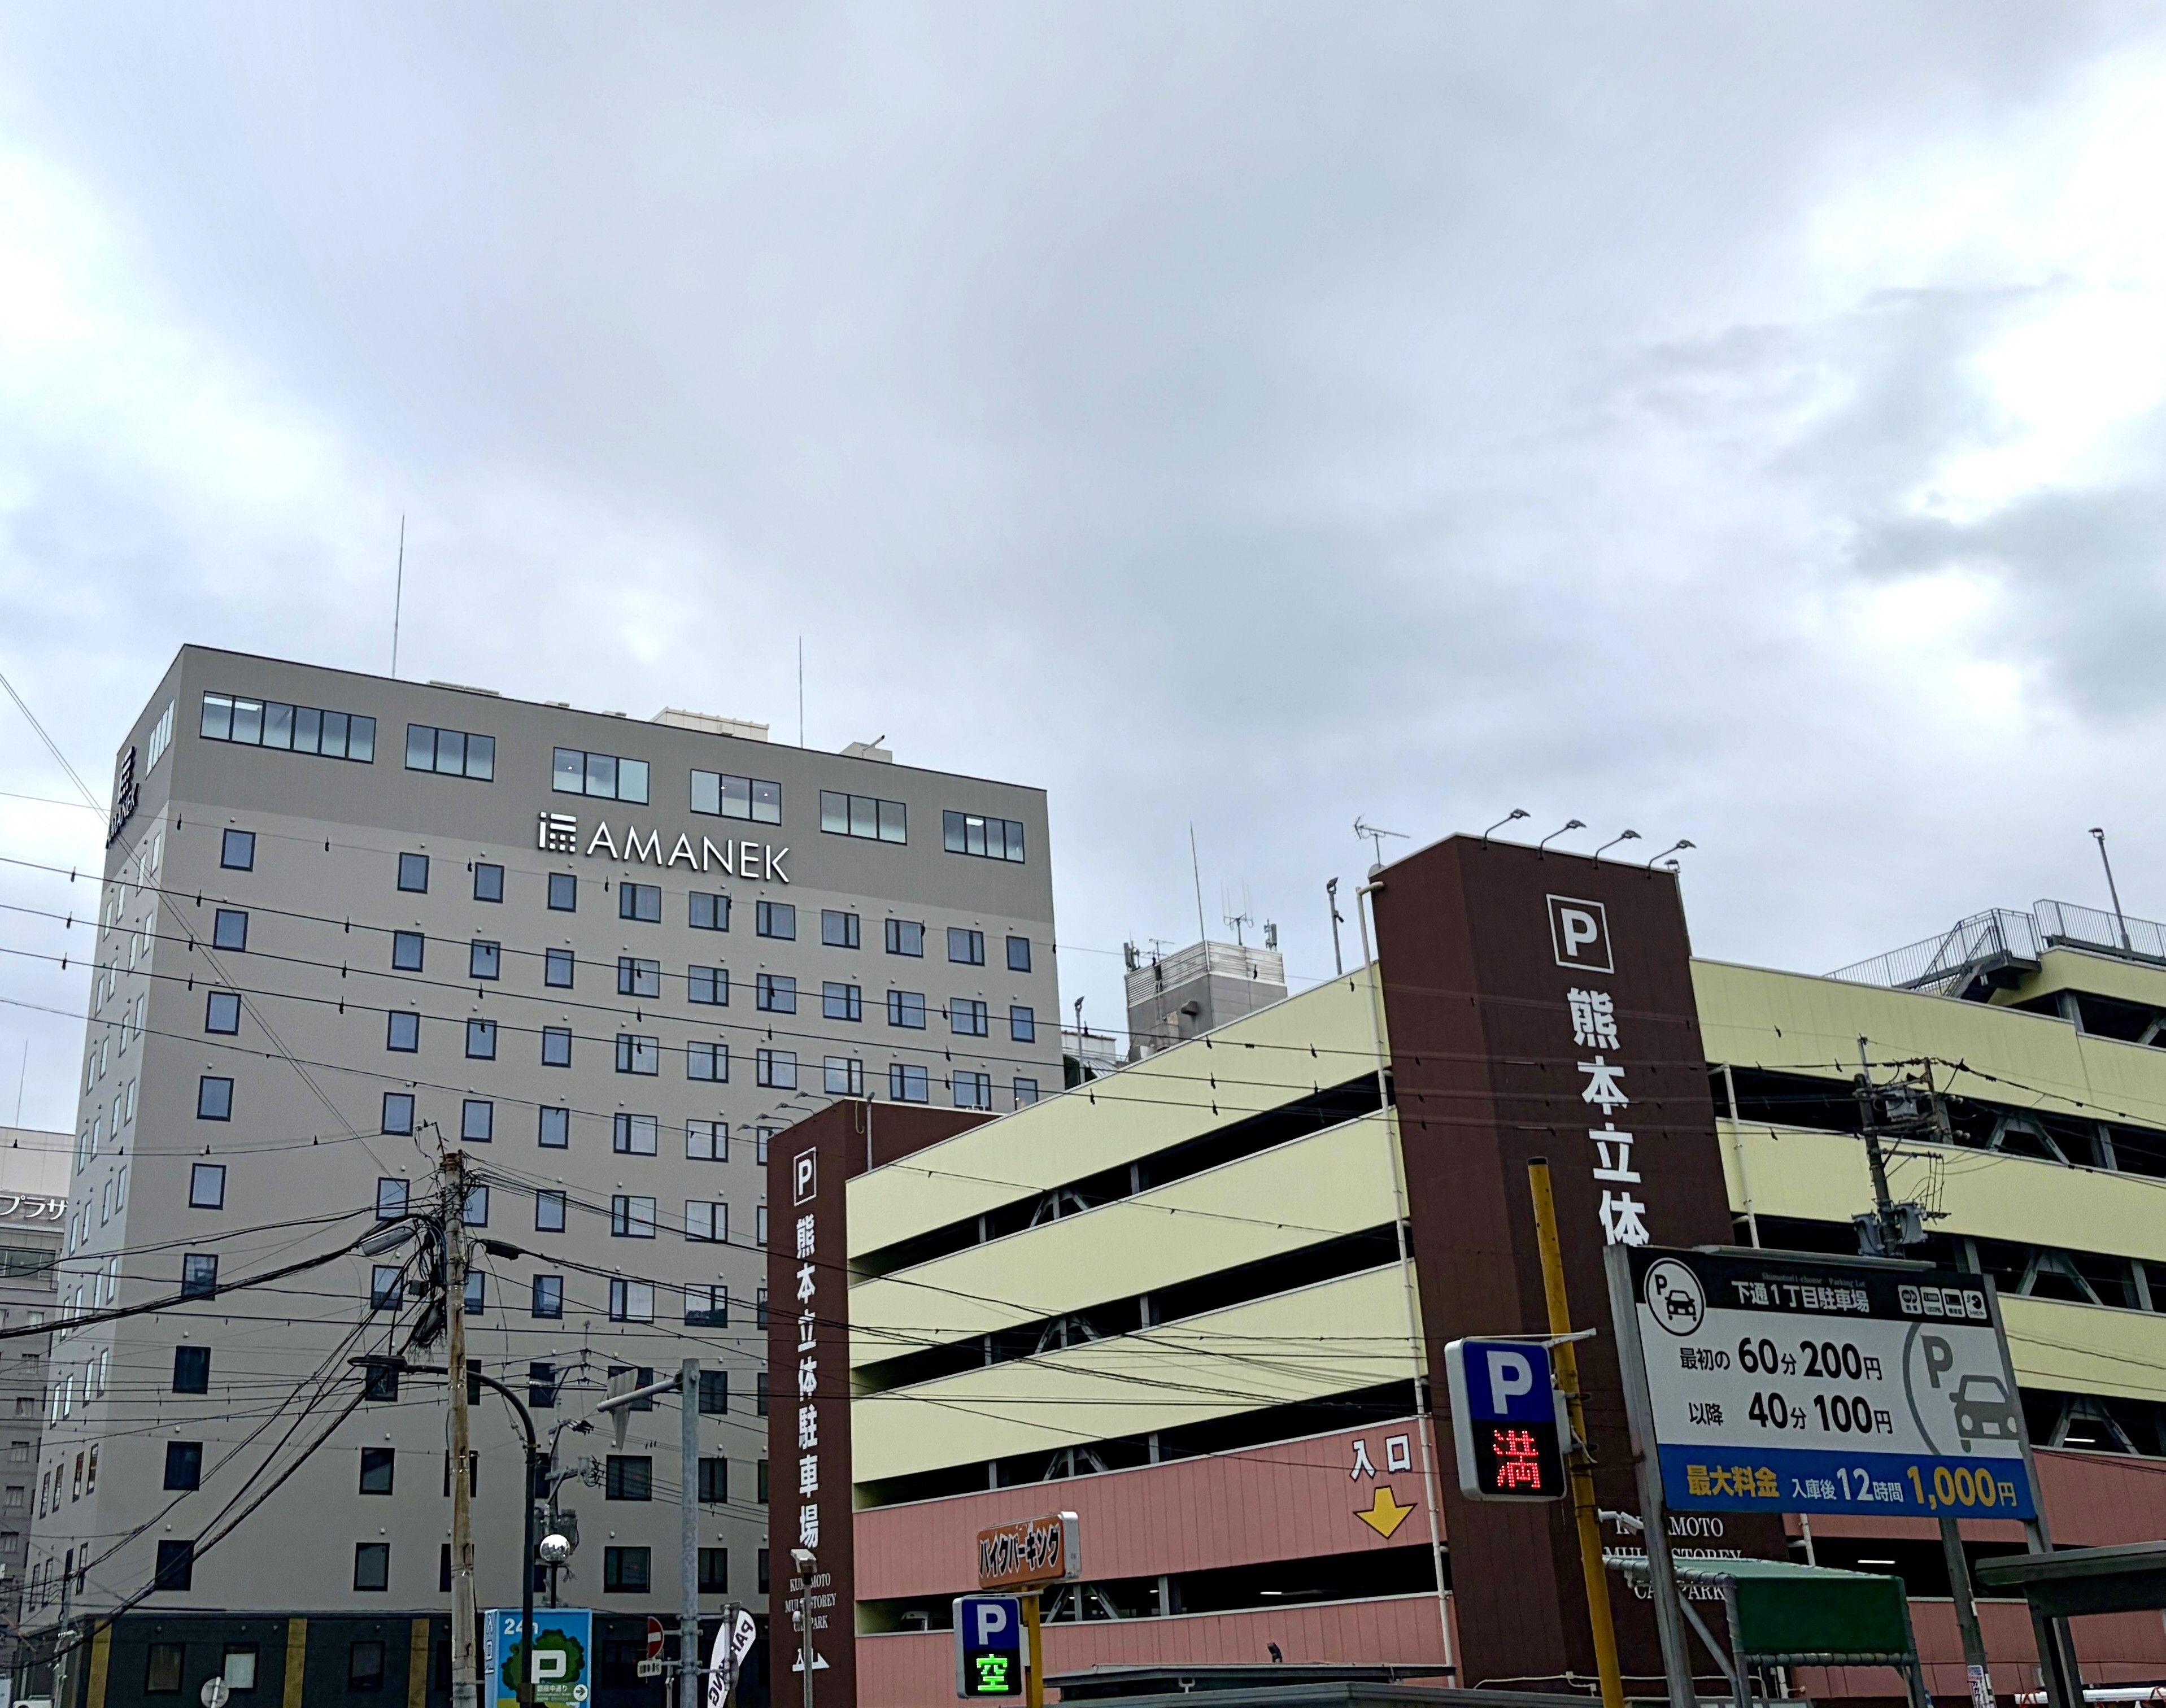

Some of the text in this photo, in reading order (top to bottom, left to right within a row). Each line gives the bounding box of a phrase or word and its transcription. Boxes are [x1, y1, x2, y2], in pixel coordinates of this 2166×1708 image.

[586, 821, 789, 883] AMANEK
[1561, 908, 1598, 957] P
[1567, 987, 1650, 1247] 熊本立体
[798, 1159, 812, 1196] P
[0, 1194, 68, 1221] プラザ
[1654, 1274, 1667, 1295] P
[1731, 1280, 1870, 1313] 下通1丁目駐車場
[796, 1214, 819, 1549] 熊本立体駐車場
[1487, 1350, 1533, 1414] P
[1921, 1335, 1954, 1388] P
[1689, 1402, 1724, 1426] 以降
[1349, 1433, 1413, 1483] 入口
[1493, 1429, 1541, 1488] 満
[1686, 1464, 1780, 1498] 最大料金
[977, 1604, 1007, 1645] P
[531, 1650, 566, 1684] P
[975, 1653, 1009, 1692] 空
